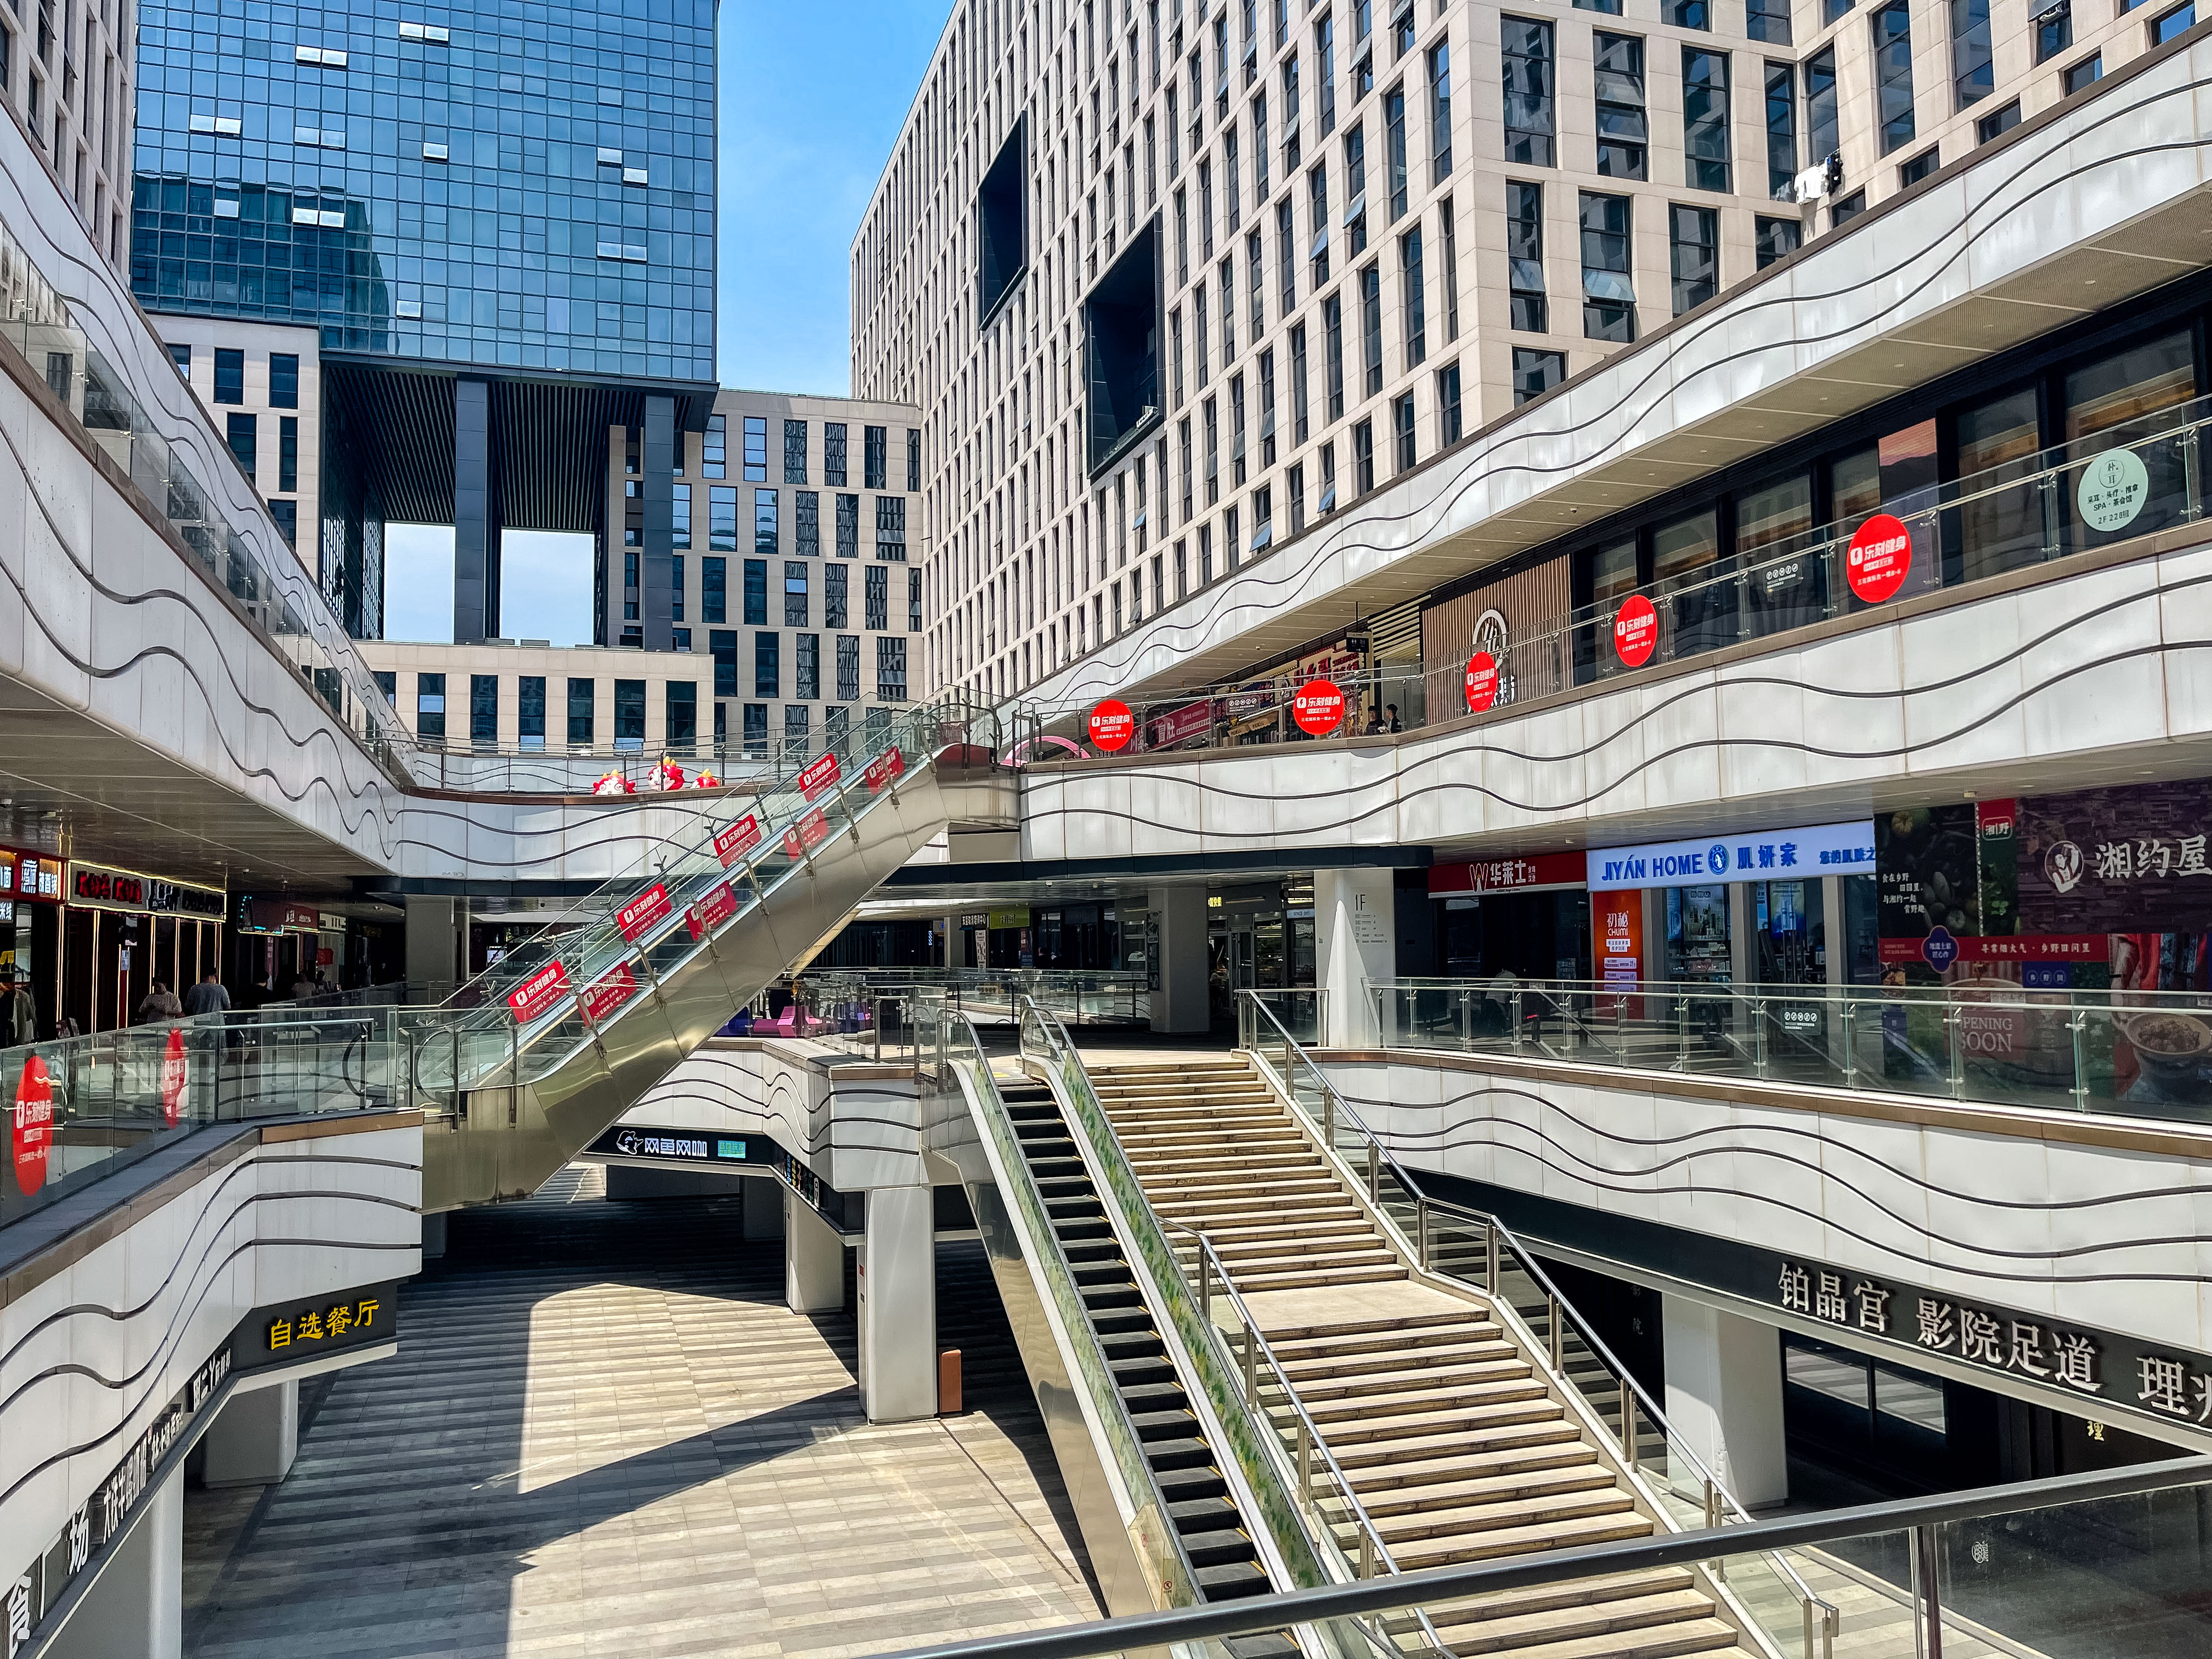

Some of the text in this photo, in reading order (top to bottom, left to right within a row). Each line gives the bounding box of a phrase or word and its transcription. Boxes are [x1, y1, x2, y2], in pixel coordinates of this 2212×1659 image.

[2094, 502, 2106, 511] SPA
[1864, 535, 1906, 561] 乐刻健身
[1627, 613, 1654, 632] 乐刻健身
[1474, 668, 1495, 682] 乐刻健身
[1307, 696, 1340, 707] 乐刻健身
[1101, 715, 1130, 725] 乐刻健身
[811, 759, 832, 781] 乐刻健身
[876, 752, 896, 774] 乐健身
[728, 821, 751, 844] 乐刻健身
[1601, 842, 1798, 881] JIYÁN HOME 肌妍家
[2094, 834, 2211, 878] 湘约屋
[1490, 860, 1526, 886] 华莱士
[633, 890, 660, 917] 乐刻健身
[701, 888, 726, 914] 乐刻健身
[1355, 894, 1366, 911] 1F
[527, 968, 557, 998] 乐刻健身
[594, 969, 624, 1000] 乐刻健身
[1962, 1017, 2013, 1031] PENING
[645, 1137, 707, 1158] 网鱼网咖
[270, 1299, 381, 1351] 自选餐厅
[1778, 1262, 1891, 1333] 铂晶宫
[1916, 1297, 2103, 1392] 影院足道
